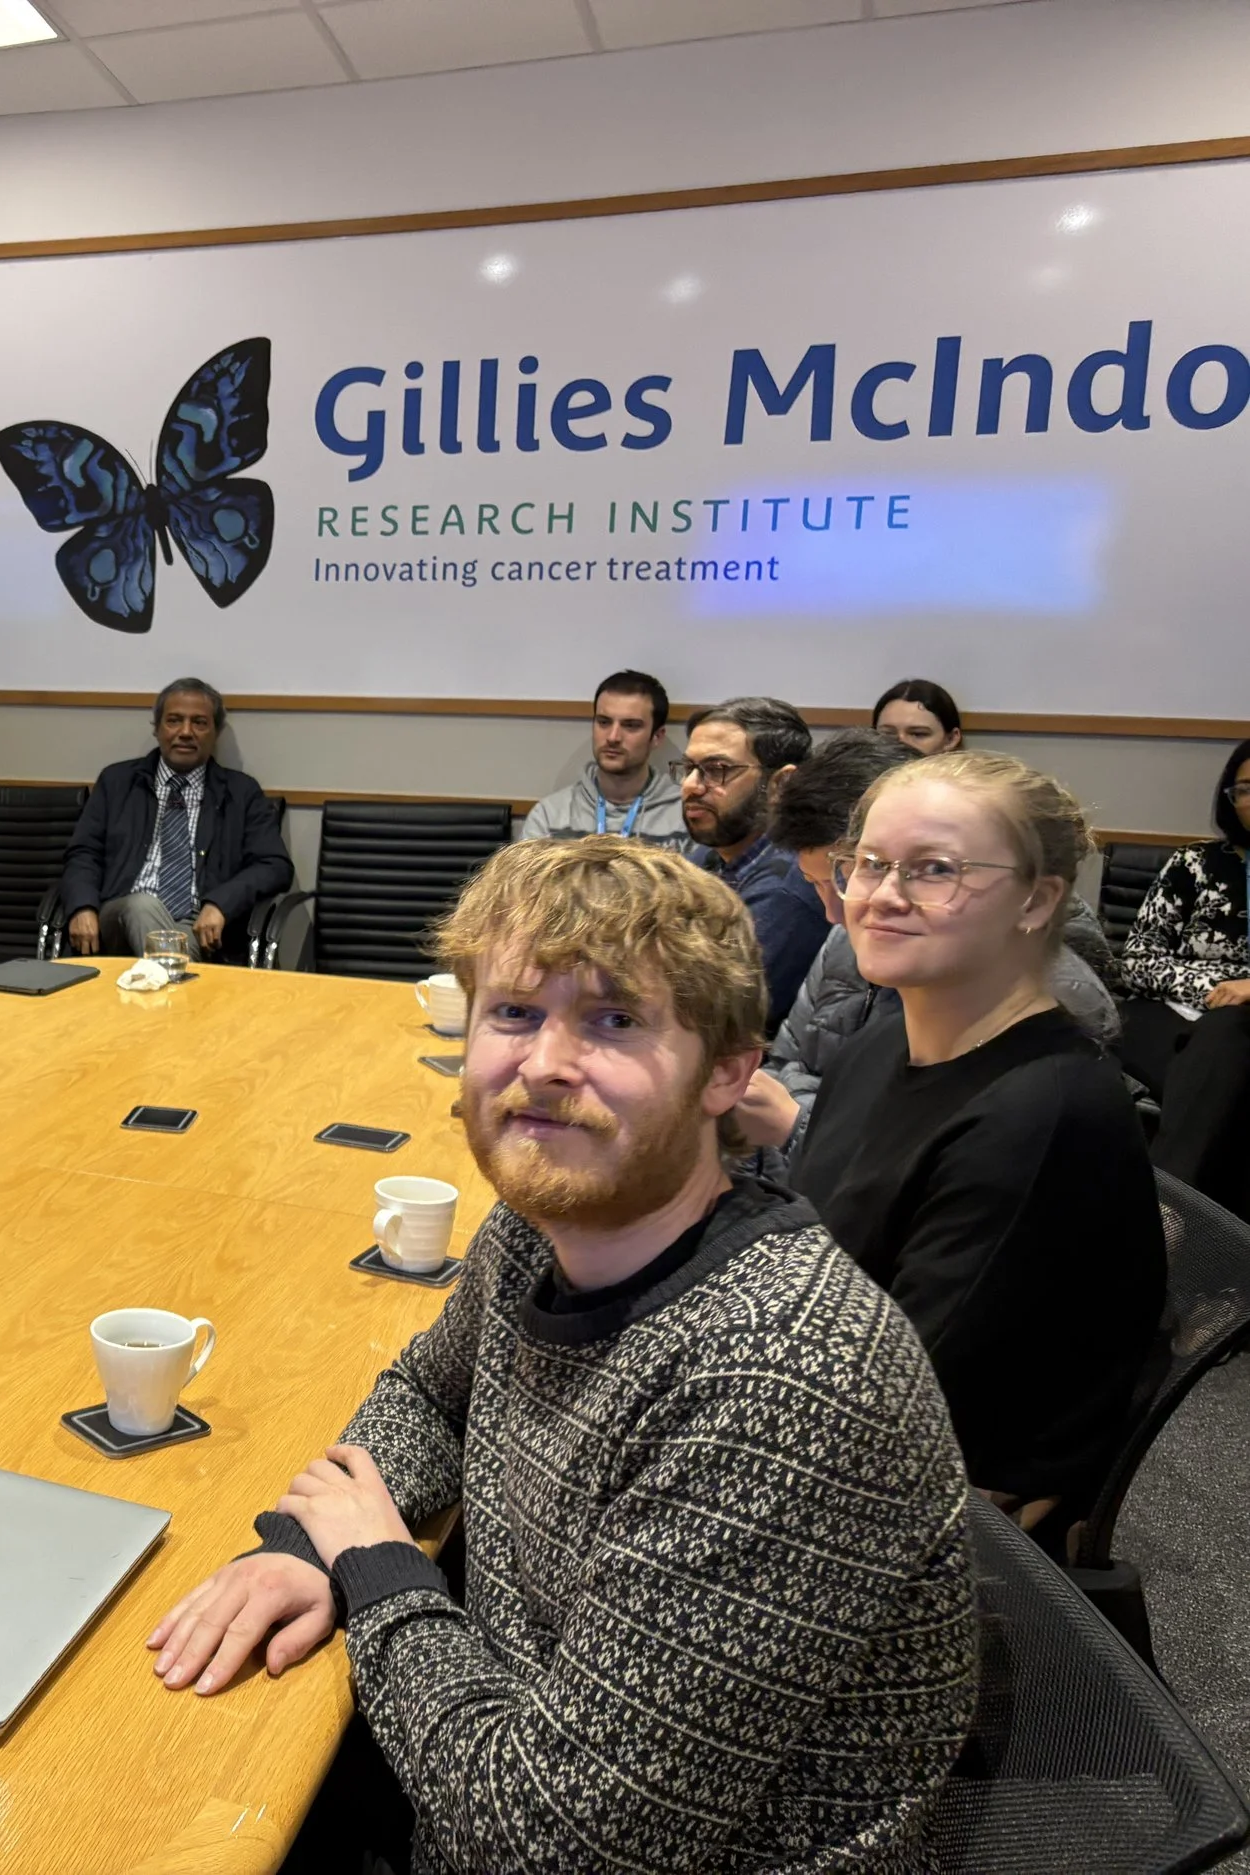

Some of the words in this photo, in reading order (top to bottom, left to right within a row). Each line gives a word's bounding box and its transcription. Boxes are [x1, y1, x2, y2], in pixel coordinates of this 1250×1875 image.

[314, 354, 673, 483] Gillies
[723, 319, 1250, 446] McIndo
[317, 501, 575, 538] RESEARCH
[608, 494, 911, 534] INSTITUTE
[314, 557, 479, 588] Innovating
[490, 560, 598, 582] cancer
[606, 555, 780, 582] treatment
